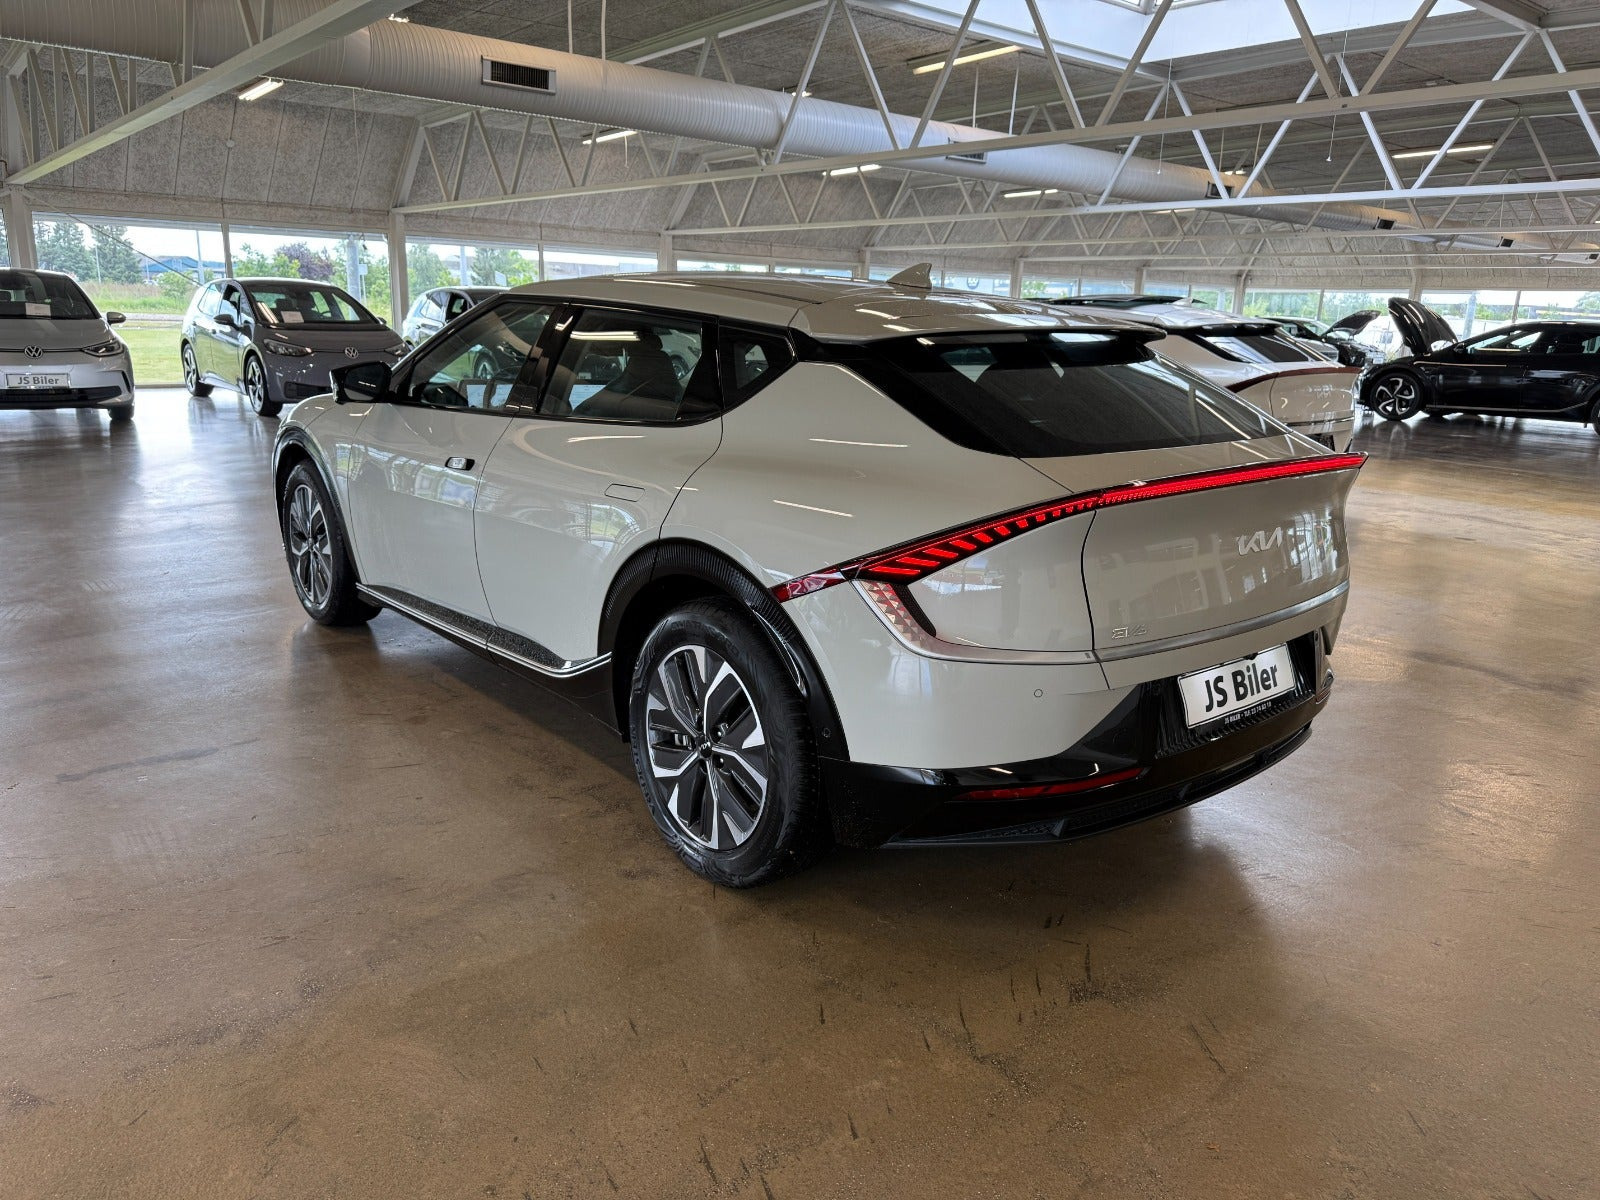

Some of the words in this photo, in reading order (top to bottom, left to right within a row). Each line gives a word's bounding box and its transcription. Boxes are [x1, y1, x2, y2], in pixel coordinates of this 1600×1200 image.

[17, 376, 30, 385] JS
[32, 376, 60, 385] Biler
[1204, 675, 1228, 713] JS
[1231, 662, 1278, 702] Biler
